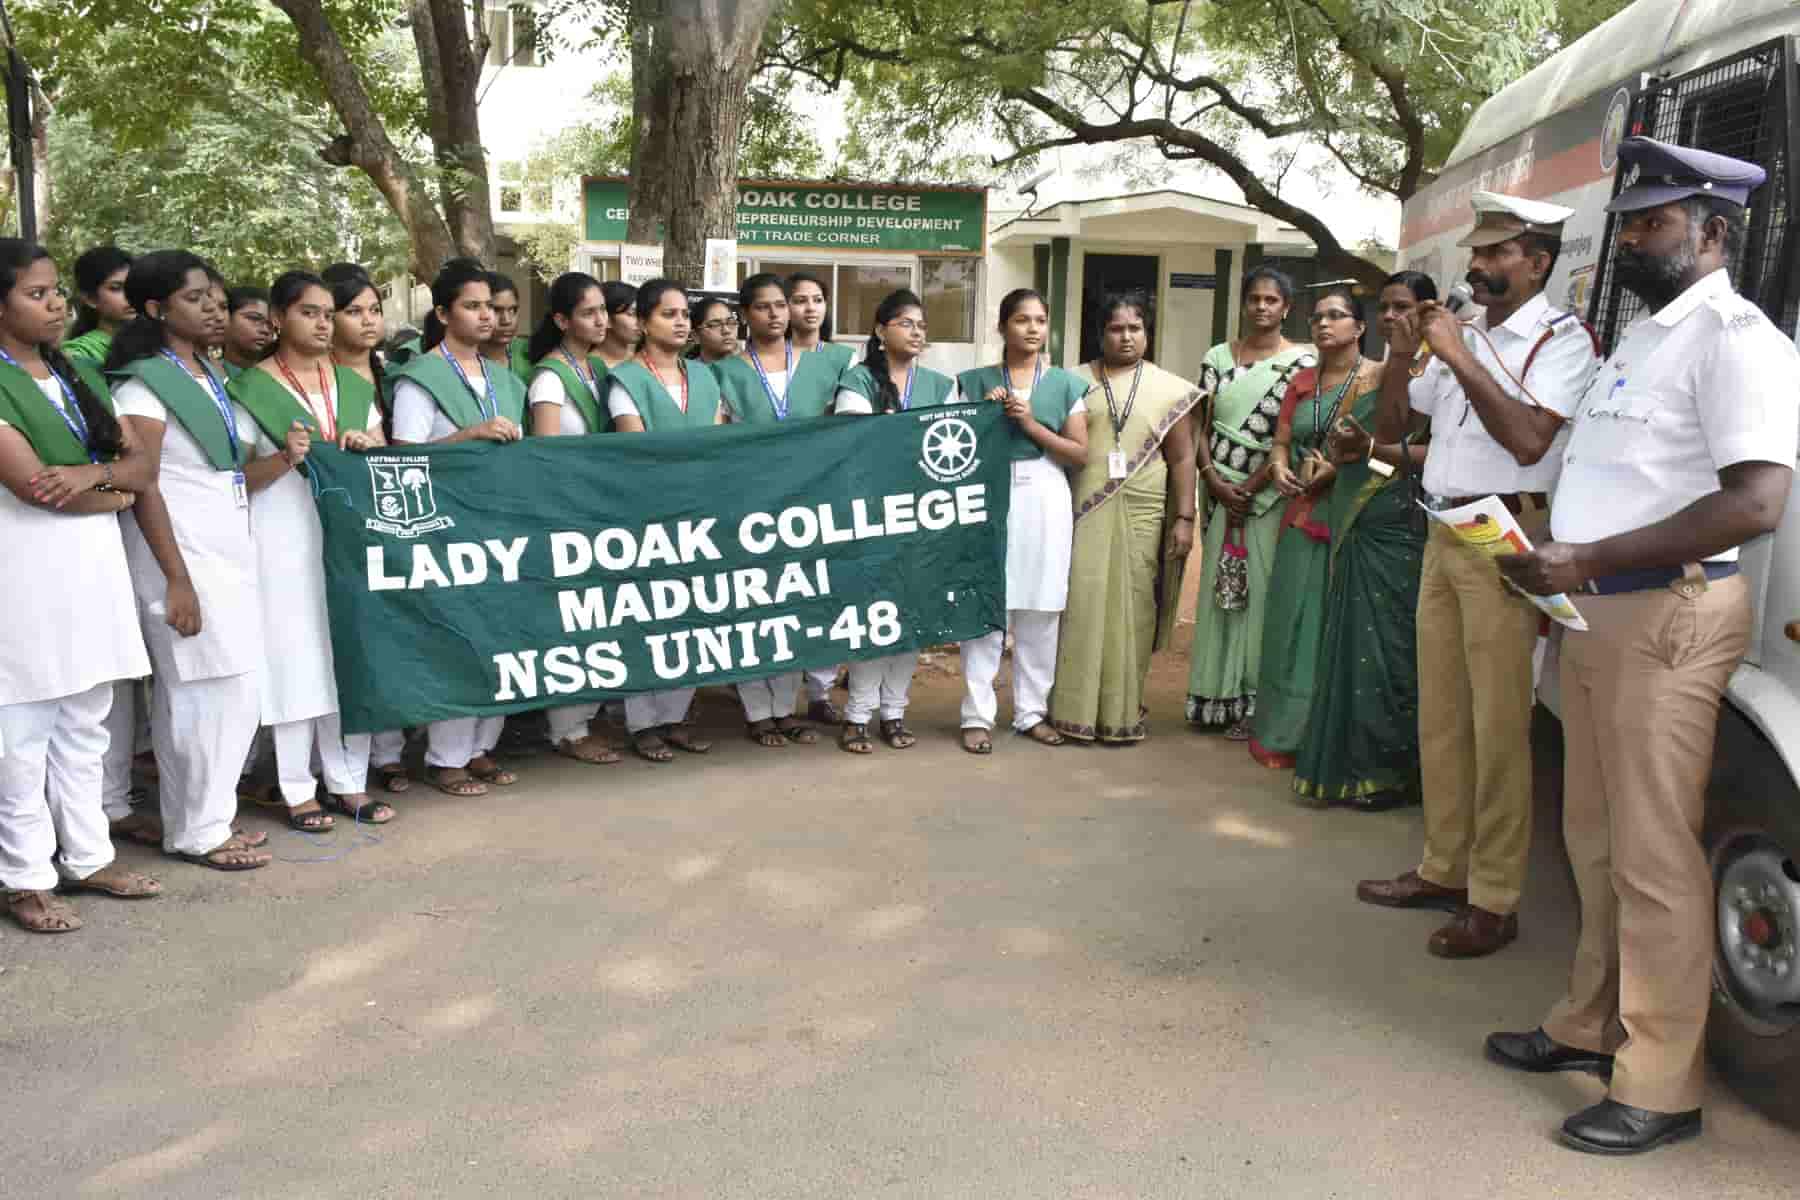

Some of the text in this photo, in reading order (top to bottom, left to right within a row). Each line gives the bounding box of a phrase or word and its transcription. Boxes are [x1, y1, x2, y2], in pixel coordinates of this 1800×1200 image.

[805, 191, 921, 212] COLLEGE
[856, 215, 963, 232] DEVELOPMENT
[763, 230, 814, 242] TRADE
[817, 231, 880, 244] CORNER
[366, 484, 988, 592] LADY DOAK COLLEGE
[558, 558, 831, 632] MADURAI
[493, 600, 902, 701] NSS UNIT-48
